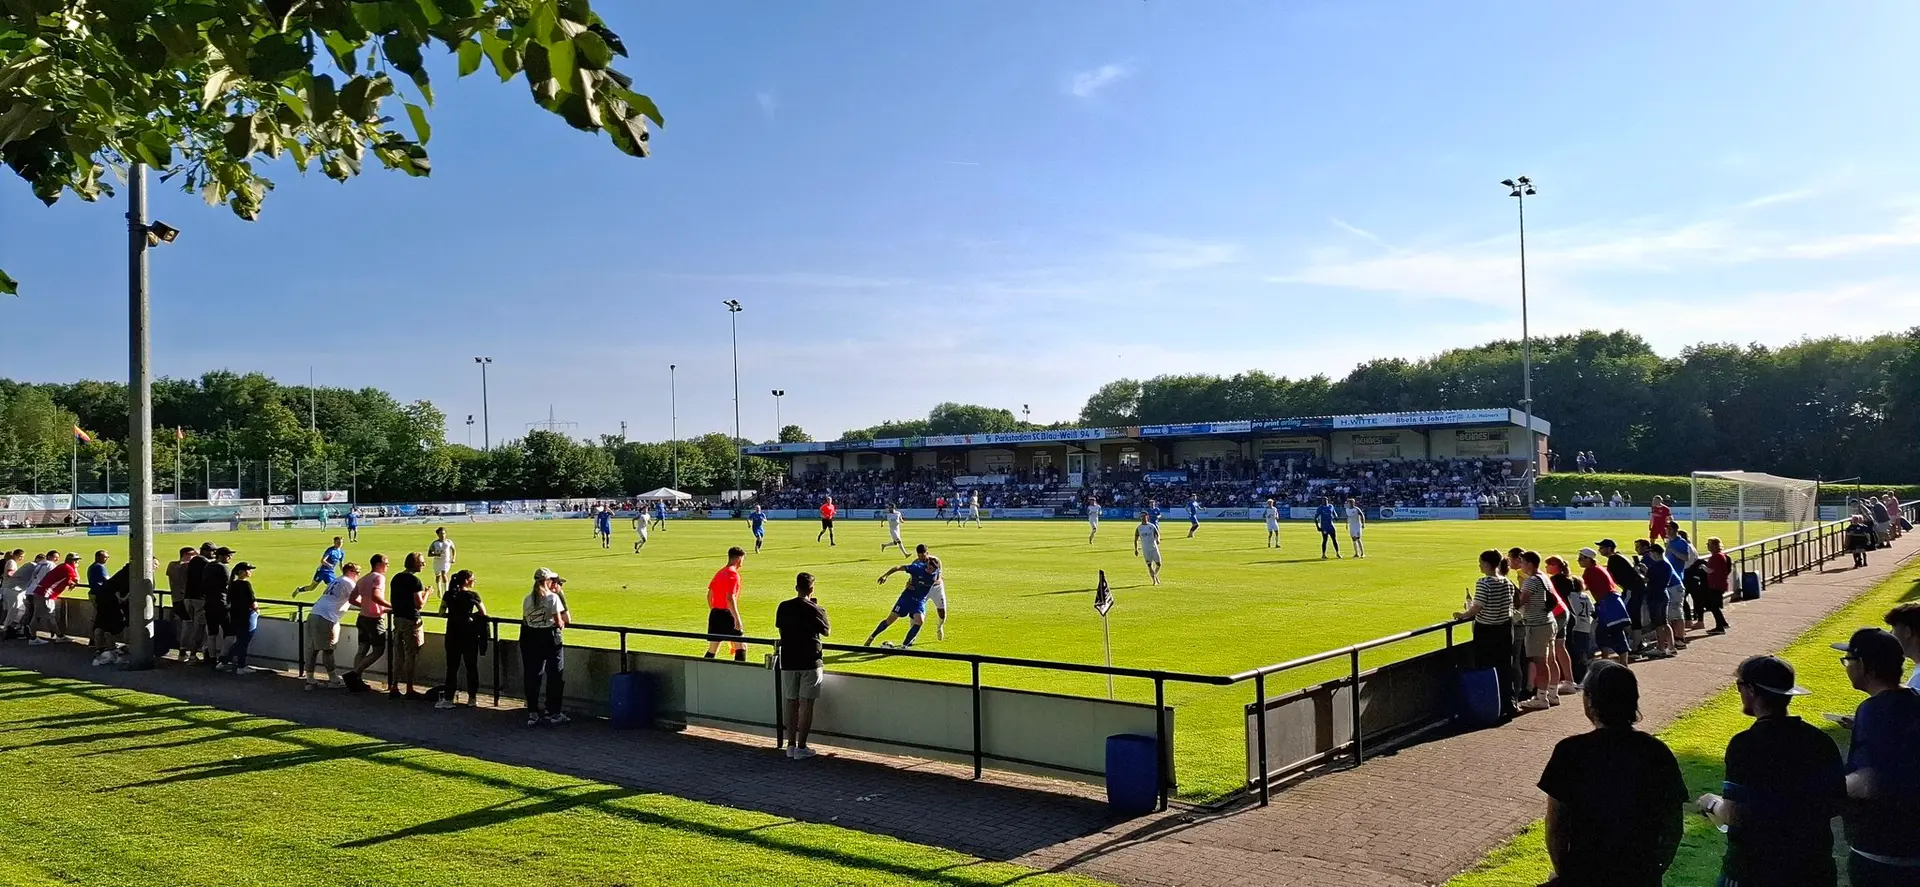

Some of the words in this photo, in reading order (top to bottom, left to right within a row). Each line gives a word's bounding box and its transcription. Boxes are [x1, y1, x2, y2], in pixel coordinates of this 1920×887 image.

[1340, 417, 1377, 426] H.WITTE
[1427, 414, 1444, 422] Sohn
[995, 432, 1032, 442] Parkstadion
[1032, 432, 1040, 440] SC
[1041, 430, 1078, 440] Blau-Weiß
[1080, 430, 1090, 438] 94
